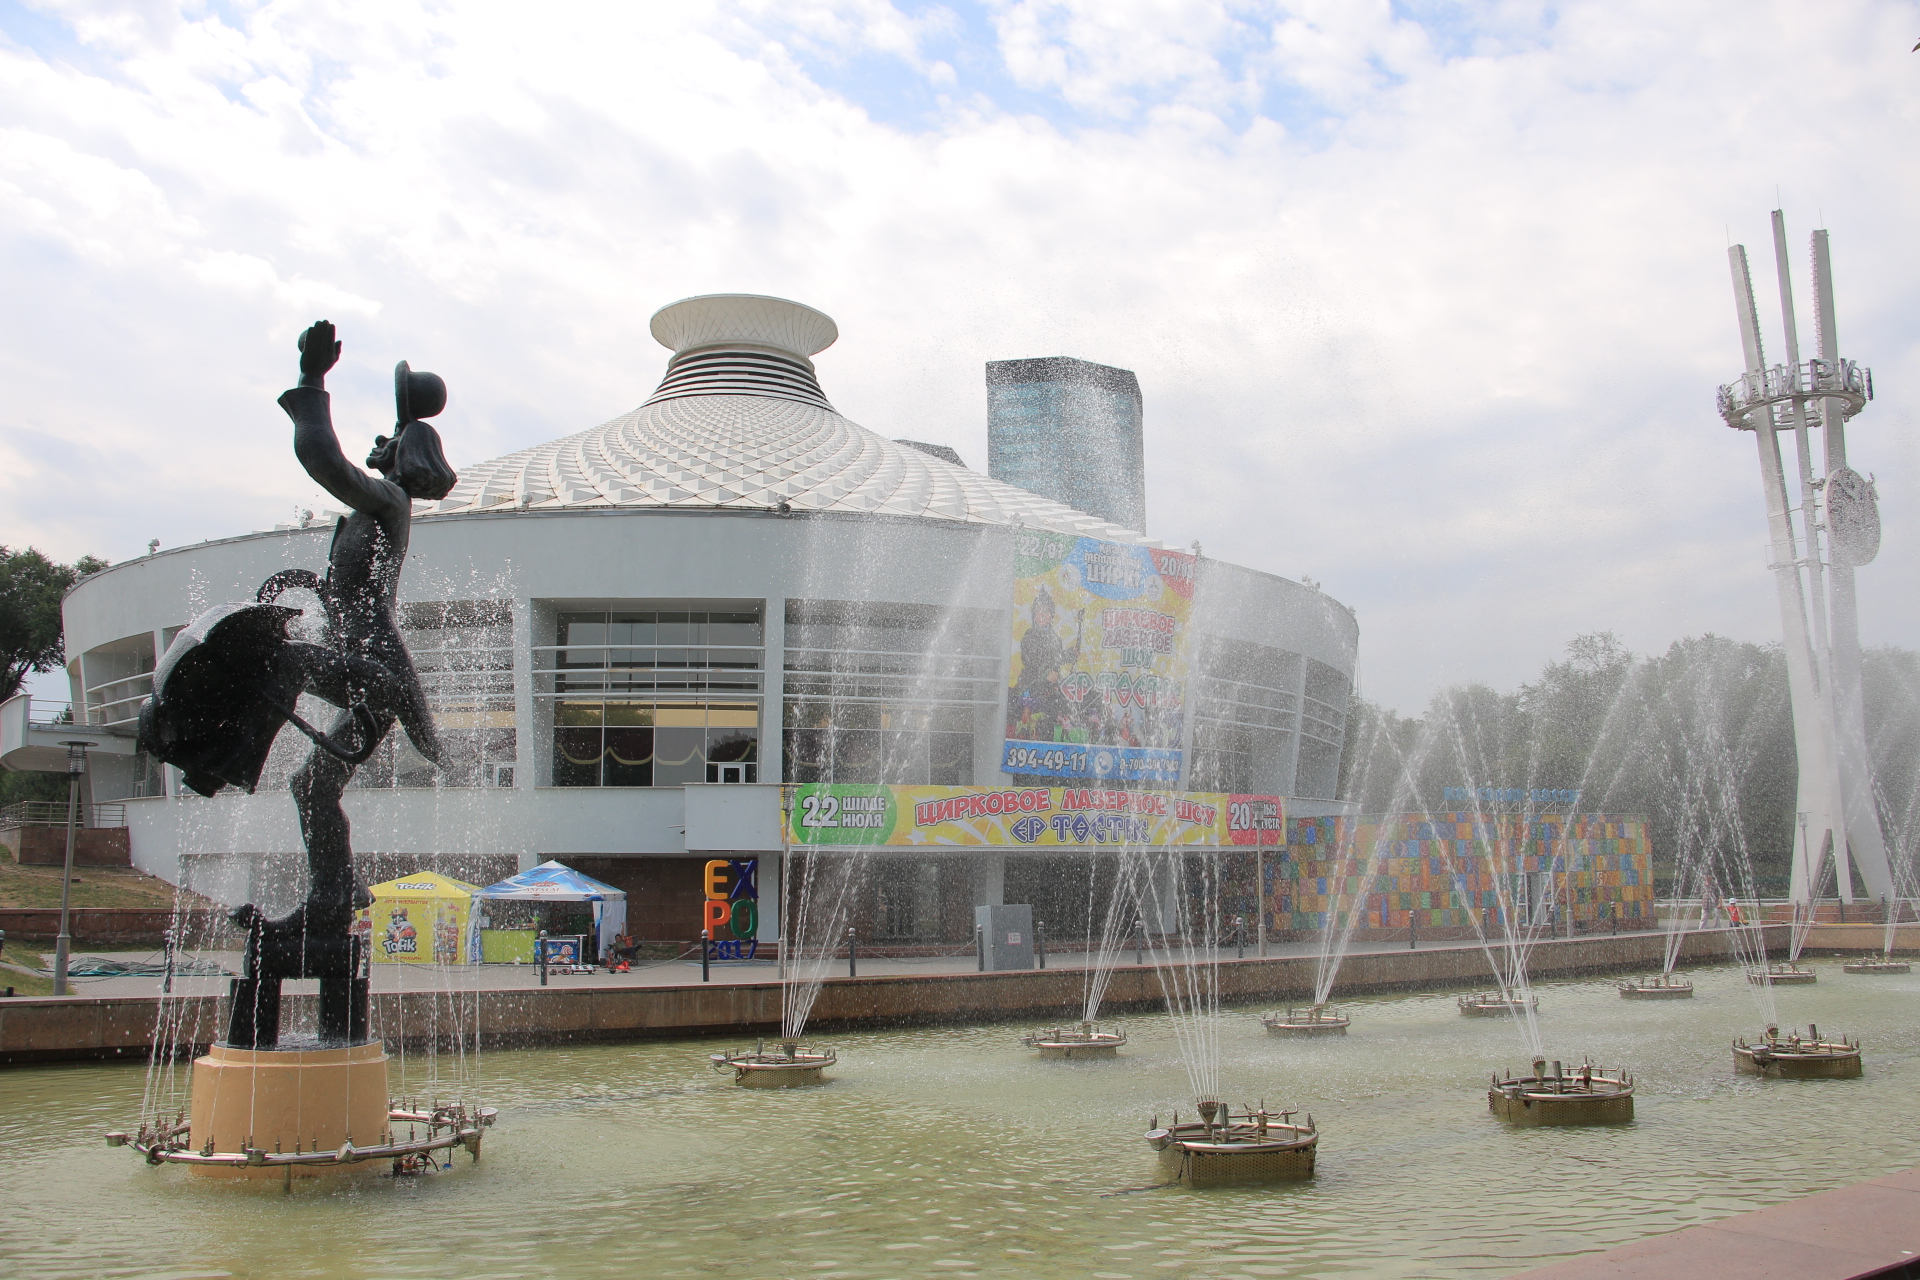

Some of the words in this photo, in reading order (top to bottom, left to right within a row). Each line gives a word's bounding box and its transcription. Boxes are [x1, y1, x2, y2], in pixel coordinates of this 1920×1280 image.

[1102, 608, 1175, 635] ЦИРКОВОЕ
[1120, 647, 1154, 669] ШОУ
[1007, 747, 1087, 772] 394-49-11
[801, 795, 839, 828] 22
[915, 788, 1051, 827] ЦИРКОВОЕ
[1061, 788, 1168, 816] ЛАЗЕРНОЕ
[1173, 800, 1218, 828] ШОУ
[1229, 801, 1251, 831] 20
[842, 812, 885, 829] ИЮЛЯ
[1252, 816, 1281, 830] АГУСТА
[396, 882, 437, 891] Tofik
[382, 938, 418, 955] Tofik
[706, 939, 759, 961] 2017
